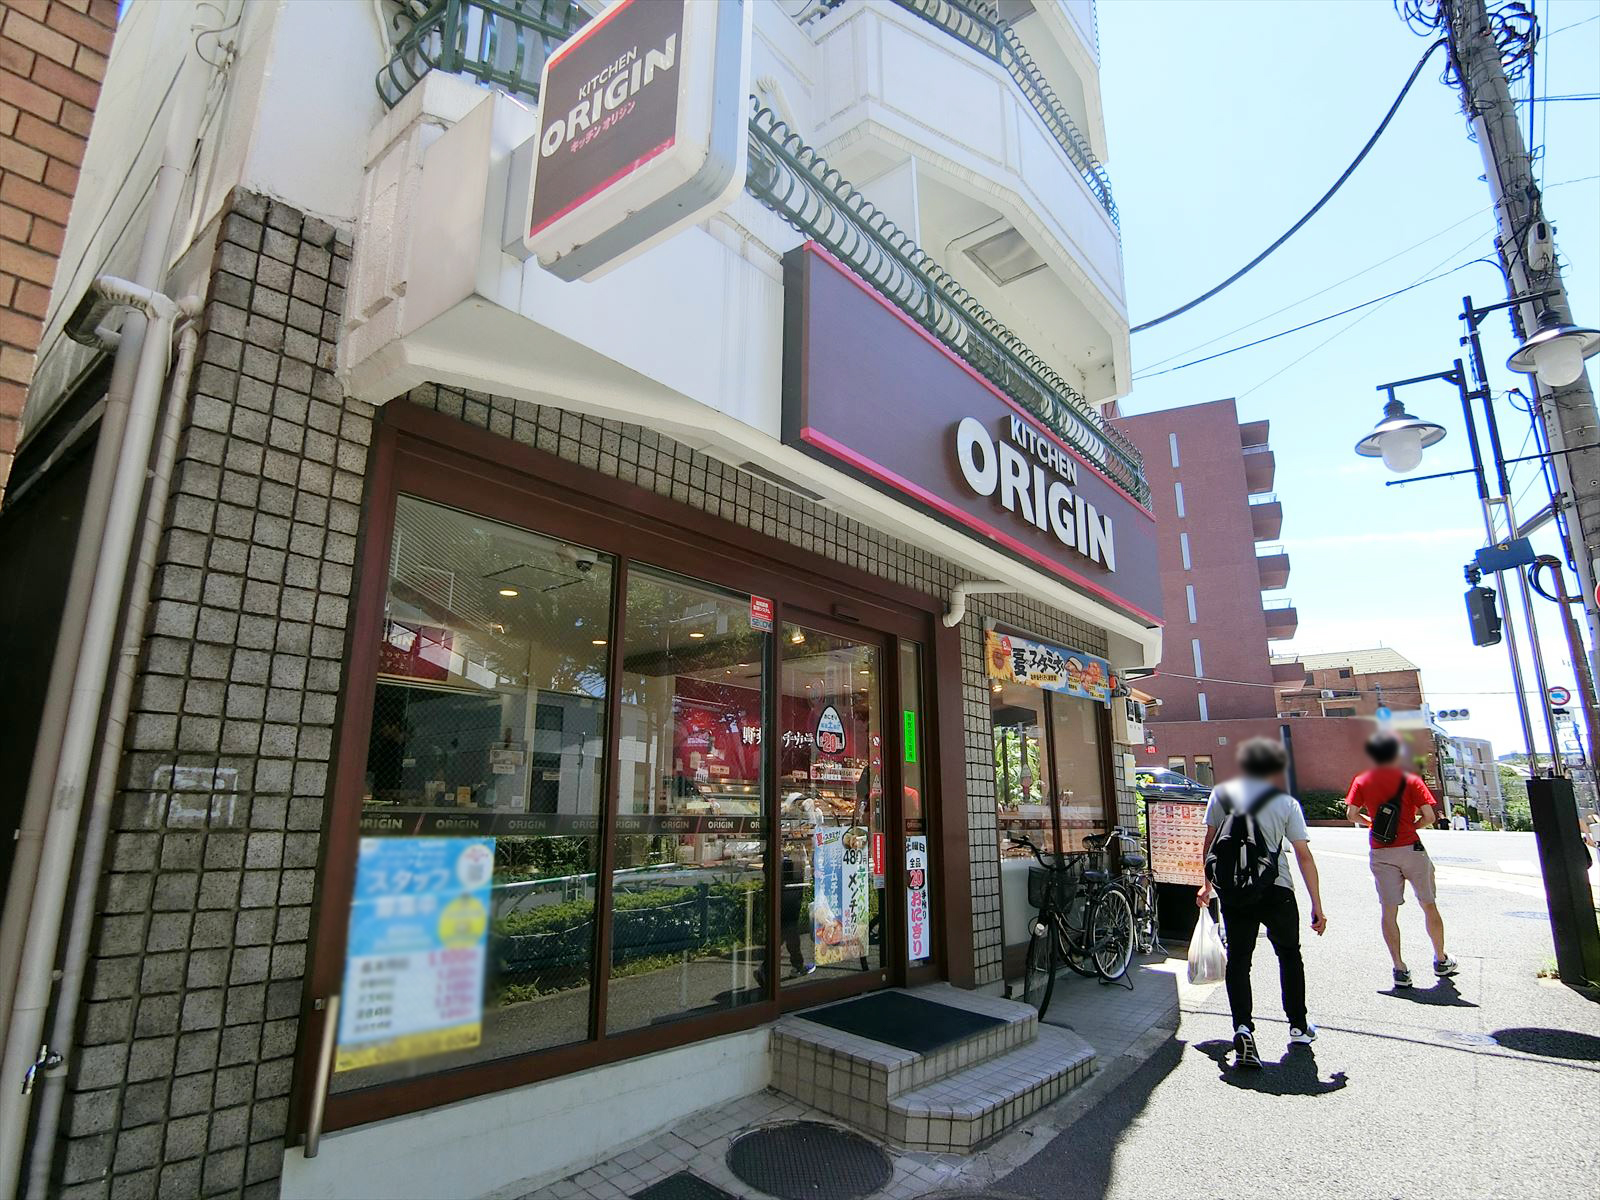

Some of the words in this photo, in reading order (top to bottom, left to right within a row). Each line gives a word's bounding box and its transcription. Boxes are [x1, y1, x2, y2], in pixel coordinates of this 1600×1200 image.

[578, 46, 637, 101] KITCHEN
[541, 32, 677, 158] ORIGIN
[1010, 413, 1078, 486] KITCHEN
[957, 416, 1116, 573] ORIGIN
[436, 819, 480, 829] ORIGIN
[508, 821, 546, 829] ORIGIN
[662, 821, 689, 829] ORIGIN
[708, 821, 734, 829] ORIGIN
